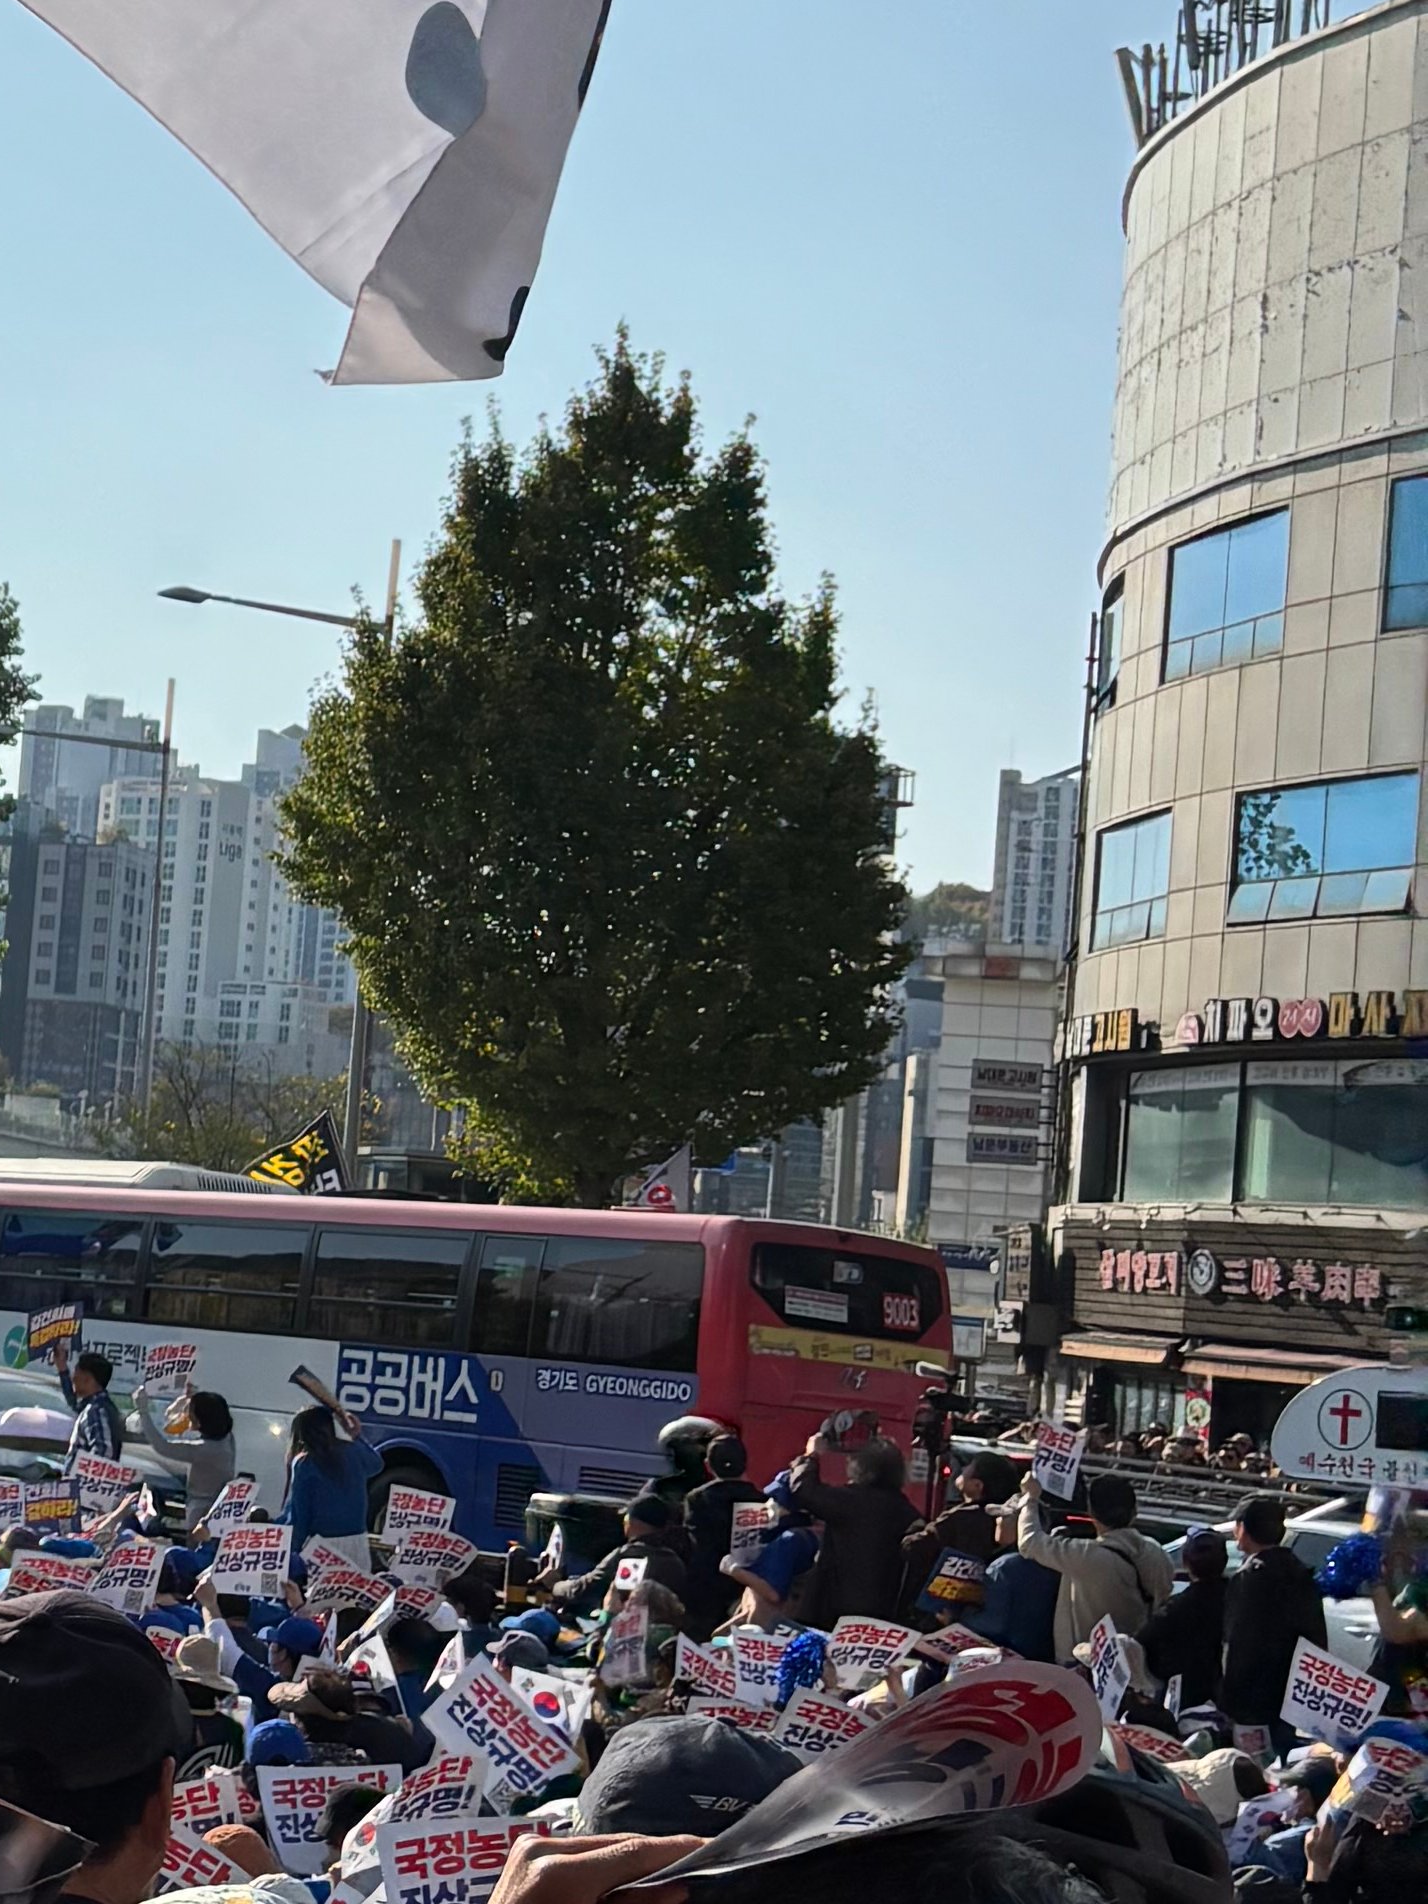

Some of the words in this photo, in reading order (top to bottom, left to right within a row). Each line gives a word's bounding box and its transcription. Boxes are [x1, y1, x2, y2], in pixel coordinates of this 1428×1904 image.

[883, 1296, 920, 1328] 9003
[339, 1348, 479, 1424] 공공버스
[536, 1369, 578, 1391] 경기도
[586, 1374, 692, 1402] GYEONGGIDO
[215, 1550, 286, 1573] 진상규명!
[223, 1528, 284, 1550] 국정농단
[1299, 1652, 1376, 1705] 국정농단
[470, 1673, 568, 1769] 국정농단
[797, 1698, 868, 1738] 국정농
[1292, 1678, 1373, 1731] 진상규명!
[446, 1693, 551, 1796] 진상규명!
